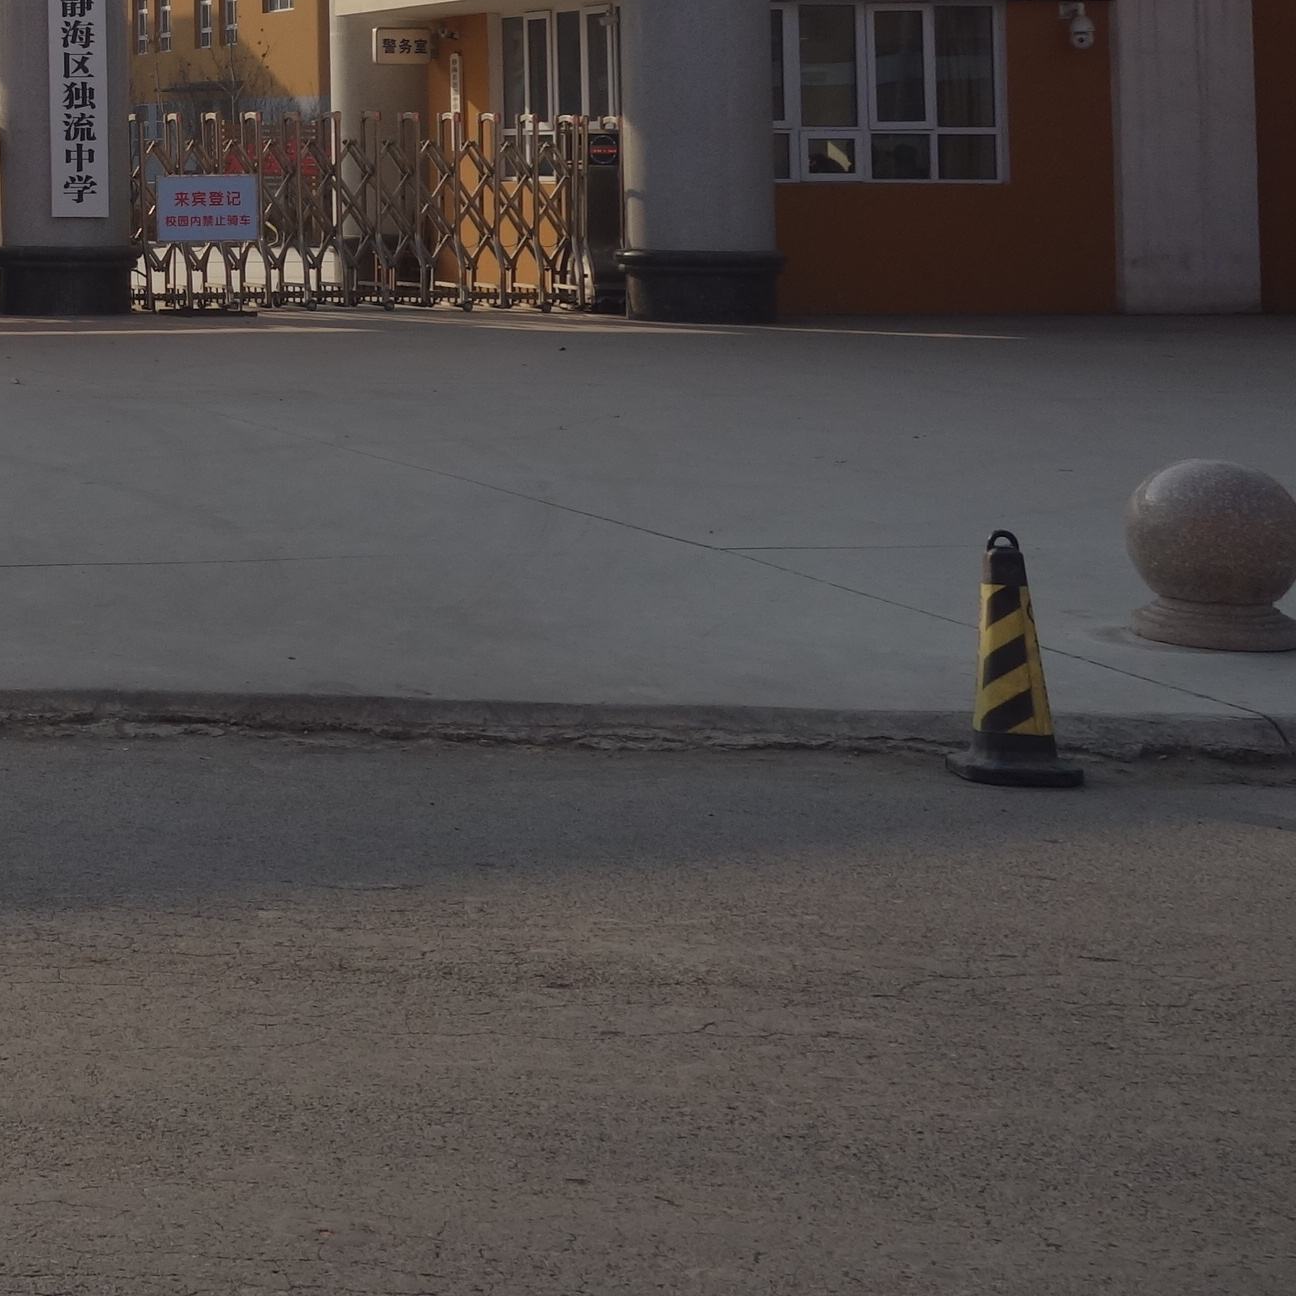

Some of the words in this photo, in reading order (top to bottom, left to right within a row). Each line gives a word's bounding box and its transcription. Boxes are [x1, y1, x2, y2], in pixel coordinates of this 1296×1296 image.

[382, 38, 428, 54] 警务室
[174, 191, 241, 207] 来宾登记
[165, 215, 251, 227] 校园内禁止骑车
